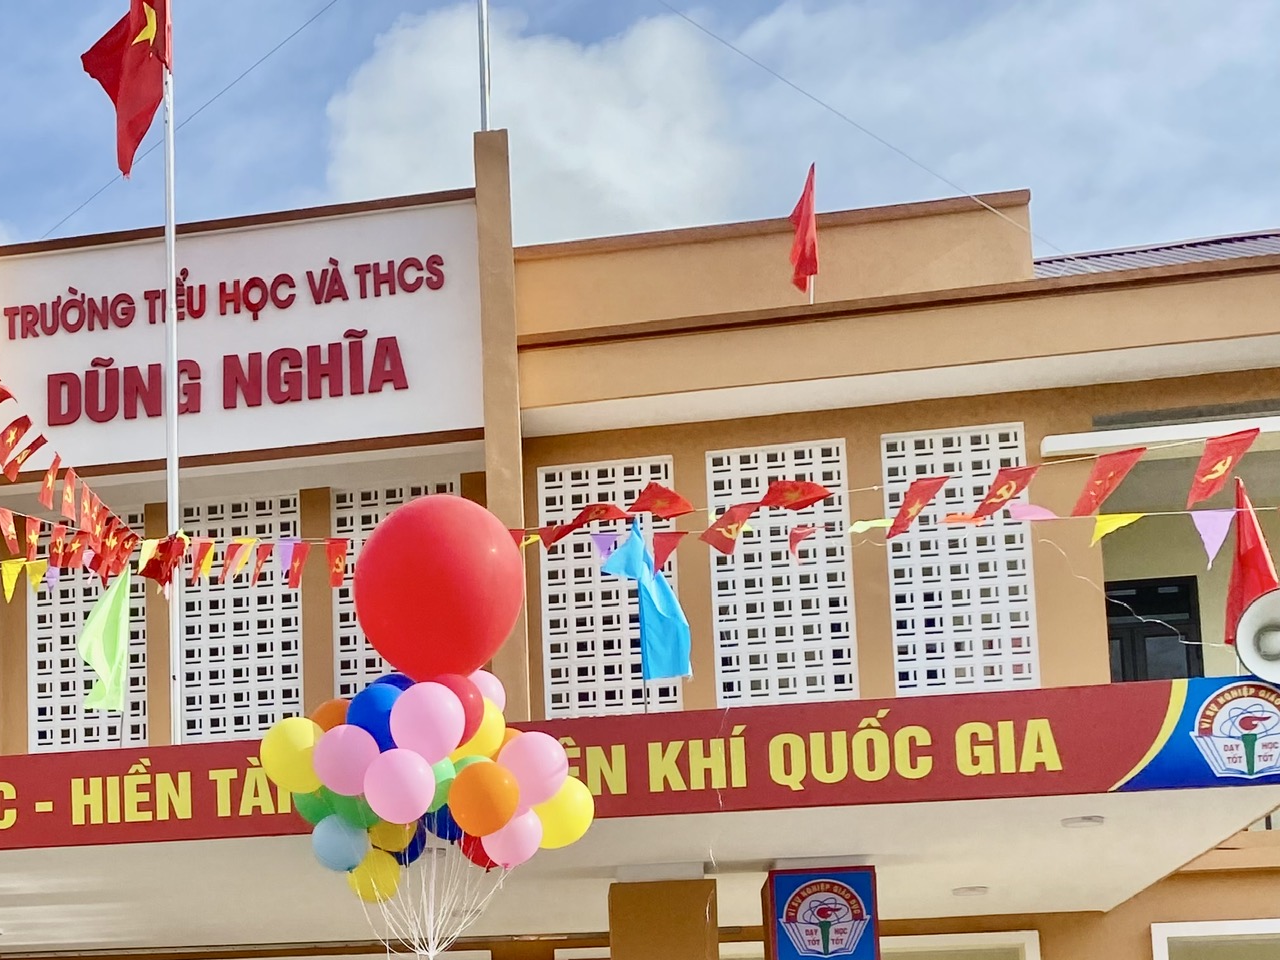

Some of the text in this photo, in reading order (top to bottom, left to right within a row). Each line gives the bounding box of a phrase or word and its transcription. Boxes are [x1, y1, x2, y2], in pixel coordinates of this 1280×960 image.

[4, 254, 446, 340] TRƯỜNG TIỂU HỌC VÀ THCS
[47, 328, 409, 427] DŨNG NGHĨA
[71, 757, 192, 826] HIỀN
[648, 724, 748, 793] KHÍ
[768, 708, 933, 791] QUỐC
[954, 718, 1063, 777] GIA
